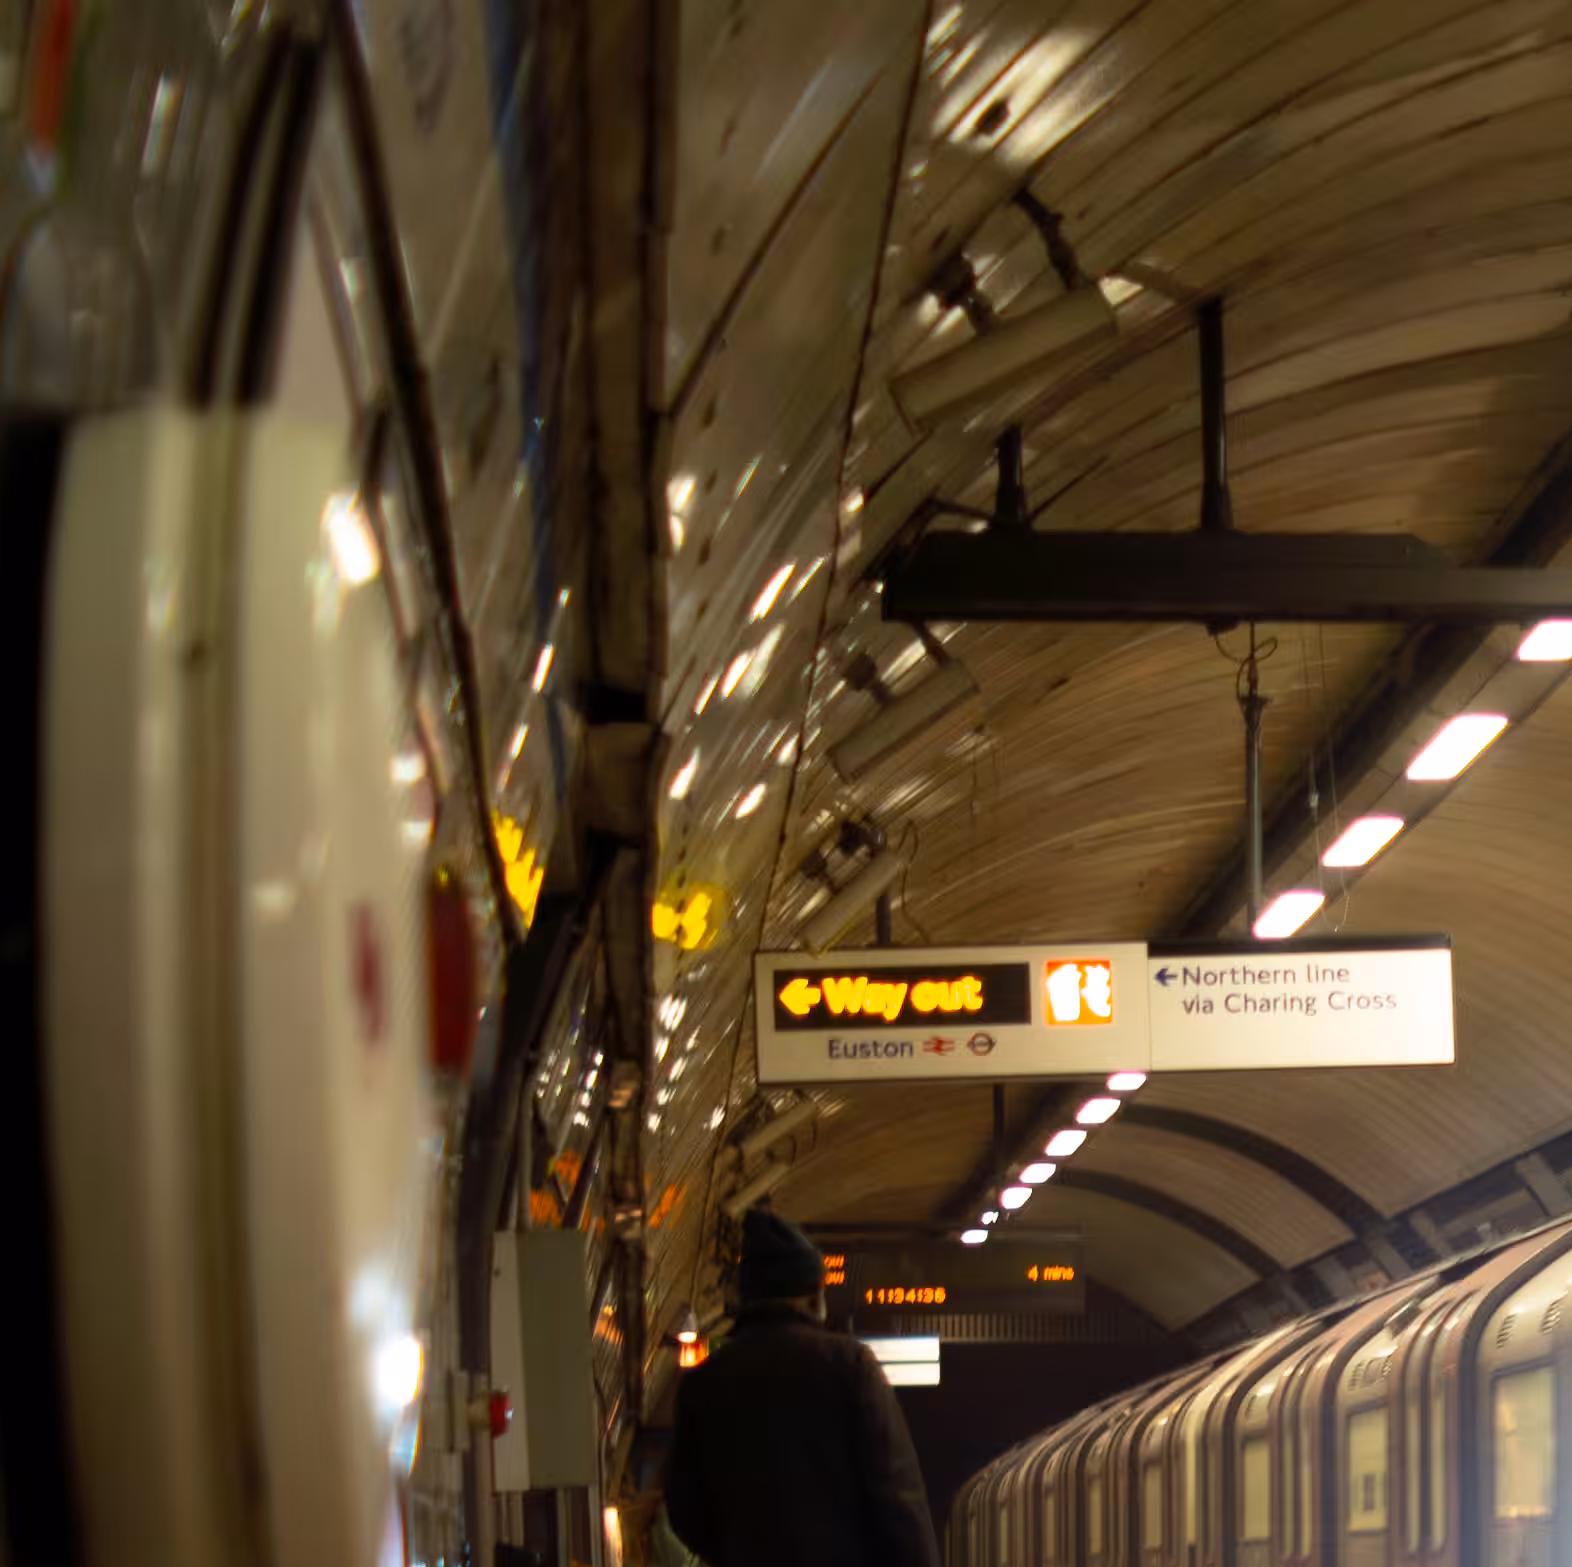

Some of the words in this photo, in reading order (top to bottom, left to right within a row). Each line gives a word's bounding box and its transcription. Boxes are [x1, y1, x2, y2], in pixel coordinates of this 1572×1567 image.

[1182, 965, 1296, 987] Northern
[1306, 963, 1350, 984] line
[821, 976, 908, 1022] Way
[909, 975, 984, 1013] out
[1182, 994, 1214, 1015] via
[1224, 991, 1317, 1017] Charing
[1328, 990, 1397, 1011] Cross
[828, 1038, 914, 1060] Euston
